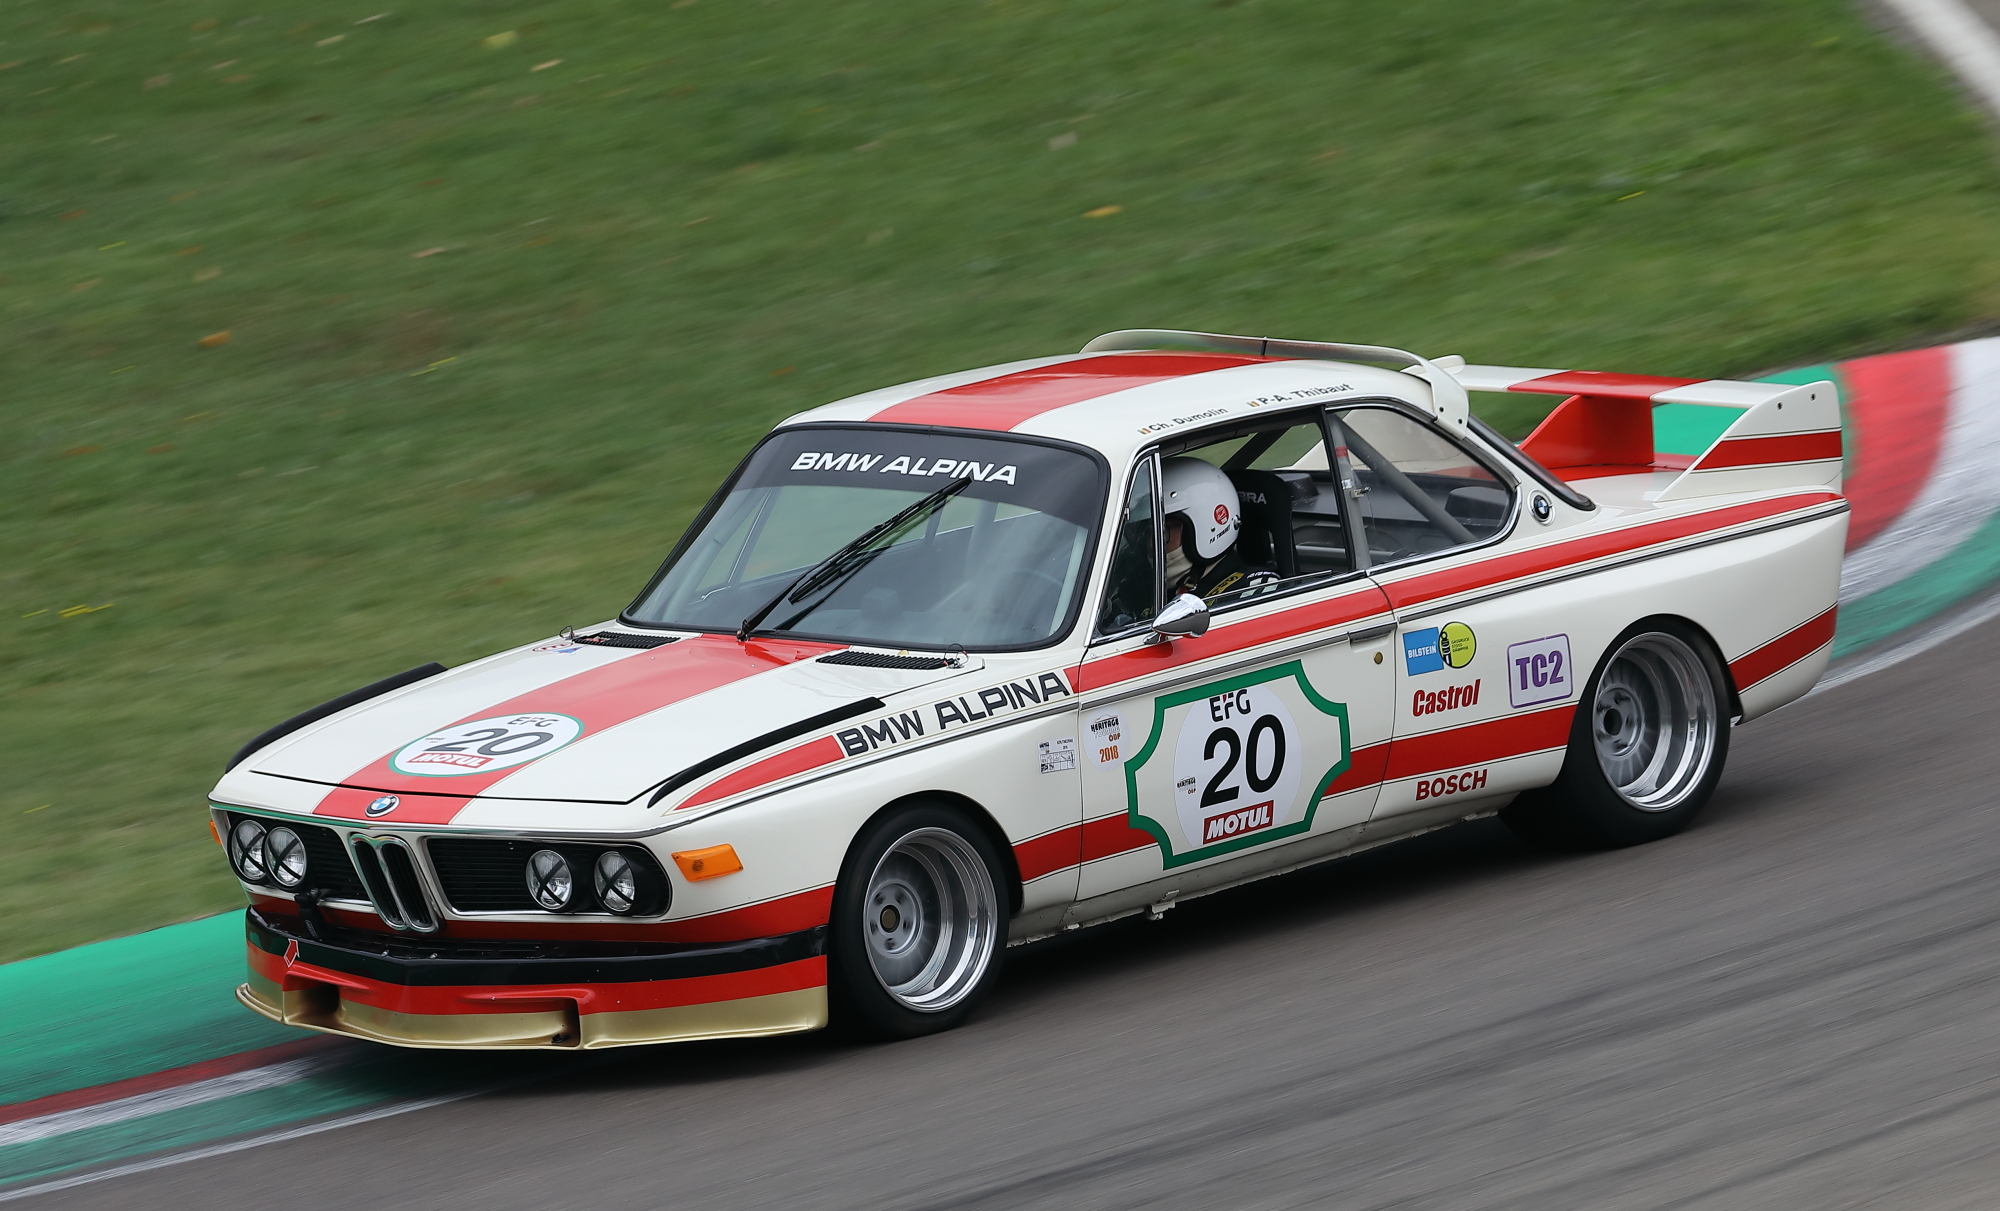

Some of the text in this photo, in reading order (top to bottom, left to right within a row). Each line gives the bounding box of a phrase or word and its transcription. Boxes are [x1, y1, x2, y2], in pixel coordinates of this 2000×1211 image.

[1291, 382, 1354, 400] Thibaut
[1148, 407, 1229, 431] Ch. Dumolin
[790, 452, 1017, 485] BMW ALPINA
[1408, 645, 1437, 659] BILSTEIN
[1515, 650, 1564, 690] TC2
[1208, 688, 1252, 722] EFG
[1412, 678, 1481, 717] Castrol
[506, 716, 560, 728] EFG
[836, 672, 1070, 757] BMW ALPINA
[1090, 718, 1120, 732] HERITAGE
[422, 728, 554, 756] 20
[1099, 745, 1119, 763] 2018
[412, 753, 488, 767] MOTUL
[1200, 714, 1287, 808] 20
[1415, 769, 1488, 801] BOSCH
[1206, 805, 1271, 841] MOTUL
